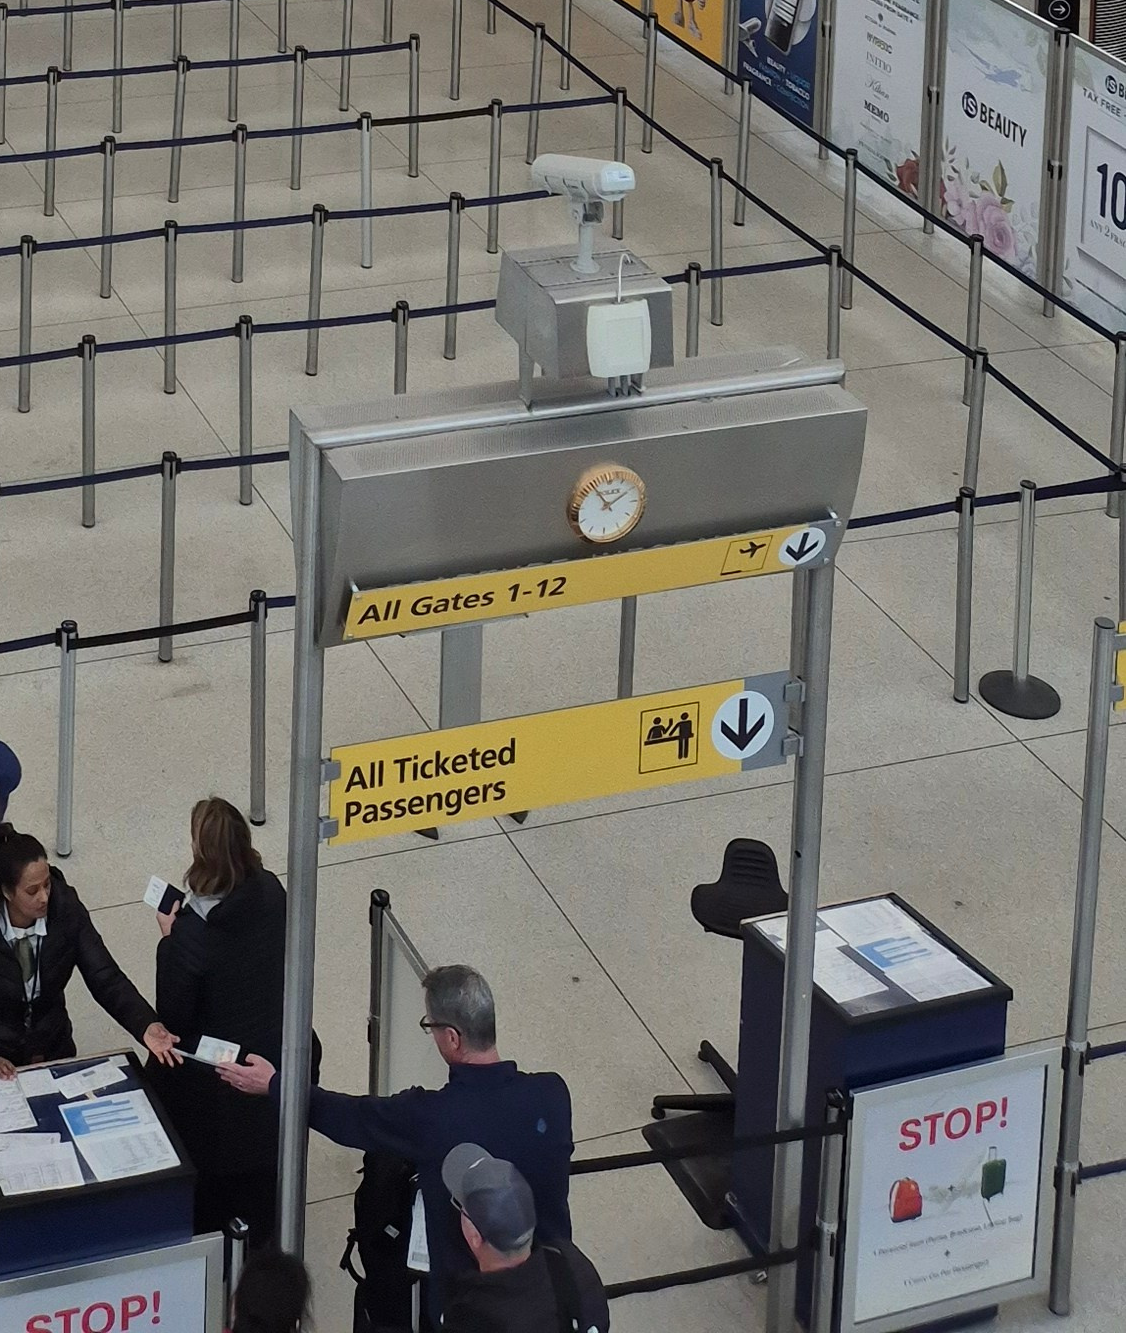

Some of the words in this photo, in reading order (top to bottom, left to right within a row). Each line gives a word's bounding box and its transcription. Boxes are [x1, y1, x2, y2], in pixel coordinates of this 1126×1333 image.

[866, 51, 892, 74] INITIO
[863, 99, 890, 123] MEMO
[979, 102, 1027, 148] BEAUTY
[1082, 87, 1099, 104] TAX
[1100, 98, 1121, 117] FREE
[358, 599, 401, 625] All
[410, 587, 495, 617] Gates
[507, 576, 567, 603] 1-12
[344, 760, 384, 793] All
[393, 737, 516, 783] Ticketed
[344, 780, 506, 827] Passengers
[898, 1096, 1008, 1152] STOP!
[25, 1290, 161, 1333] STOP!
